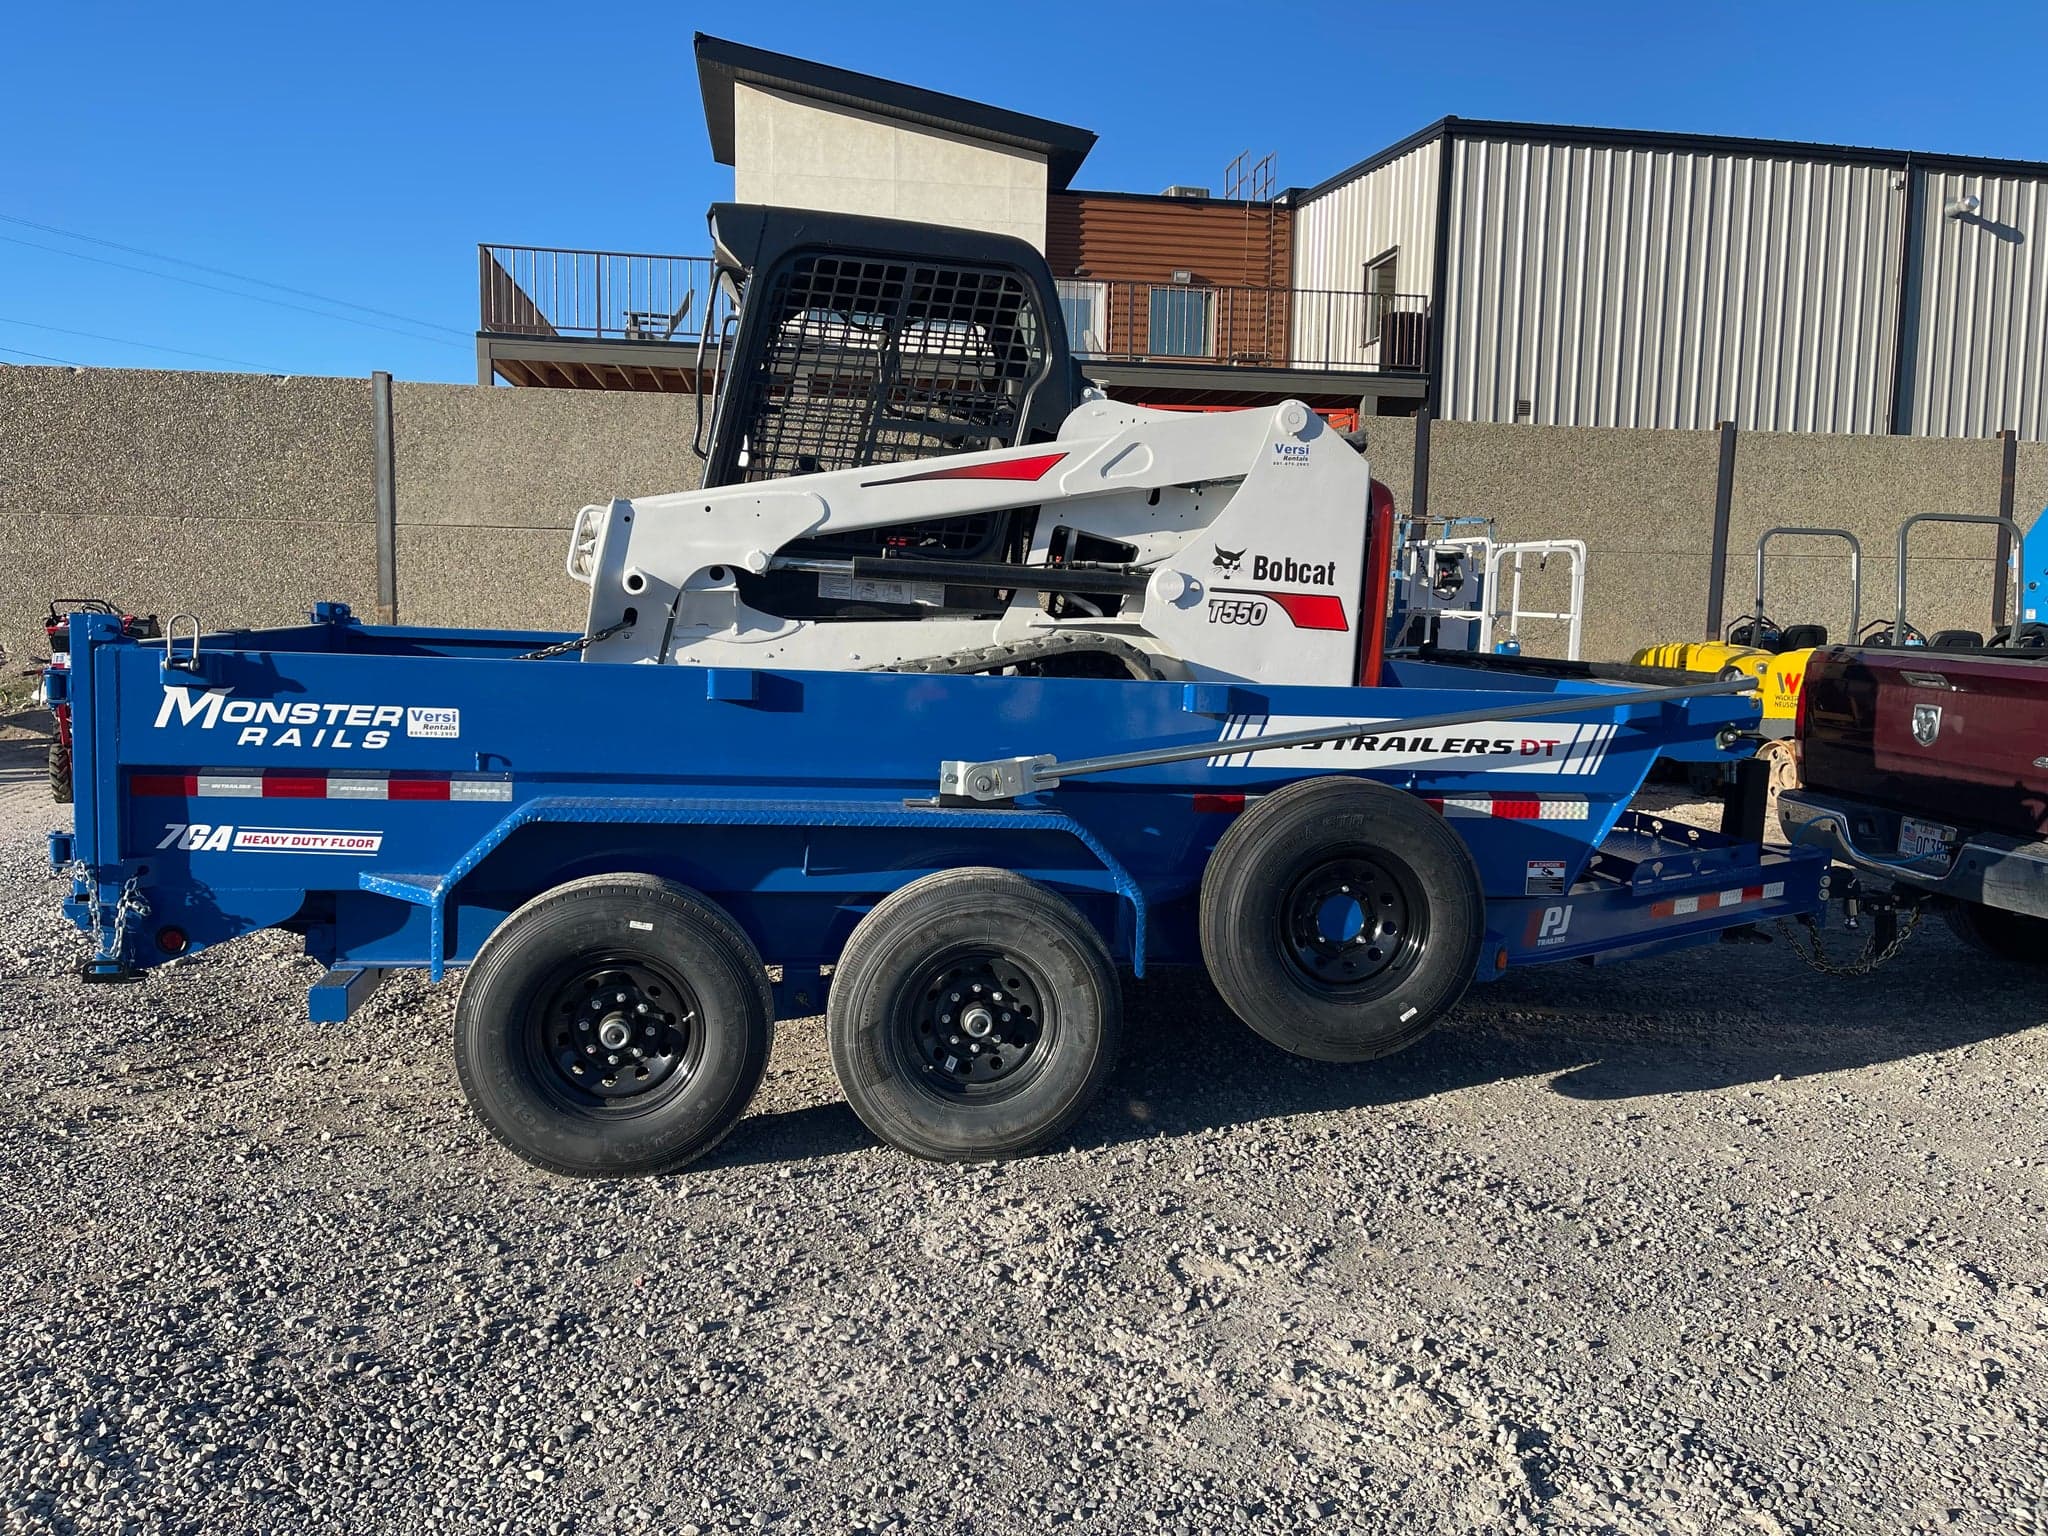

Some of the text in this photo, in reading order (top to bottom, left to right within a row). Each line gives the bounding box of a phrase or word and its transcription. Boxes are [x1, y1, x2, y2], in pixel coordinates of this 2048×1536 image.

[1275, 443, 1309, 455] Versi
[1253, 555, 1336, 586] Bobcat
[1208, 599, 1268, 626] T550
[411, 709, 457, 723] Versi
[423, 723, 456, 731] Rentals
[237, 727, 390, 749] RAILS
[1519, 739, 1560, 757] DT
[156, 824, 234, 852] 7GA
[242, 834, 375, 849] HEAVY DUTY FLOOR
[1539, 905, 1573, 937] PJ
